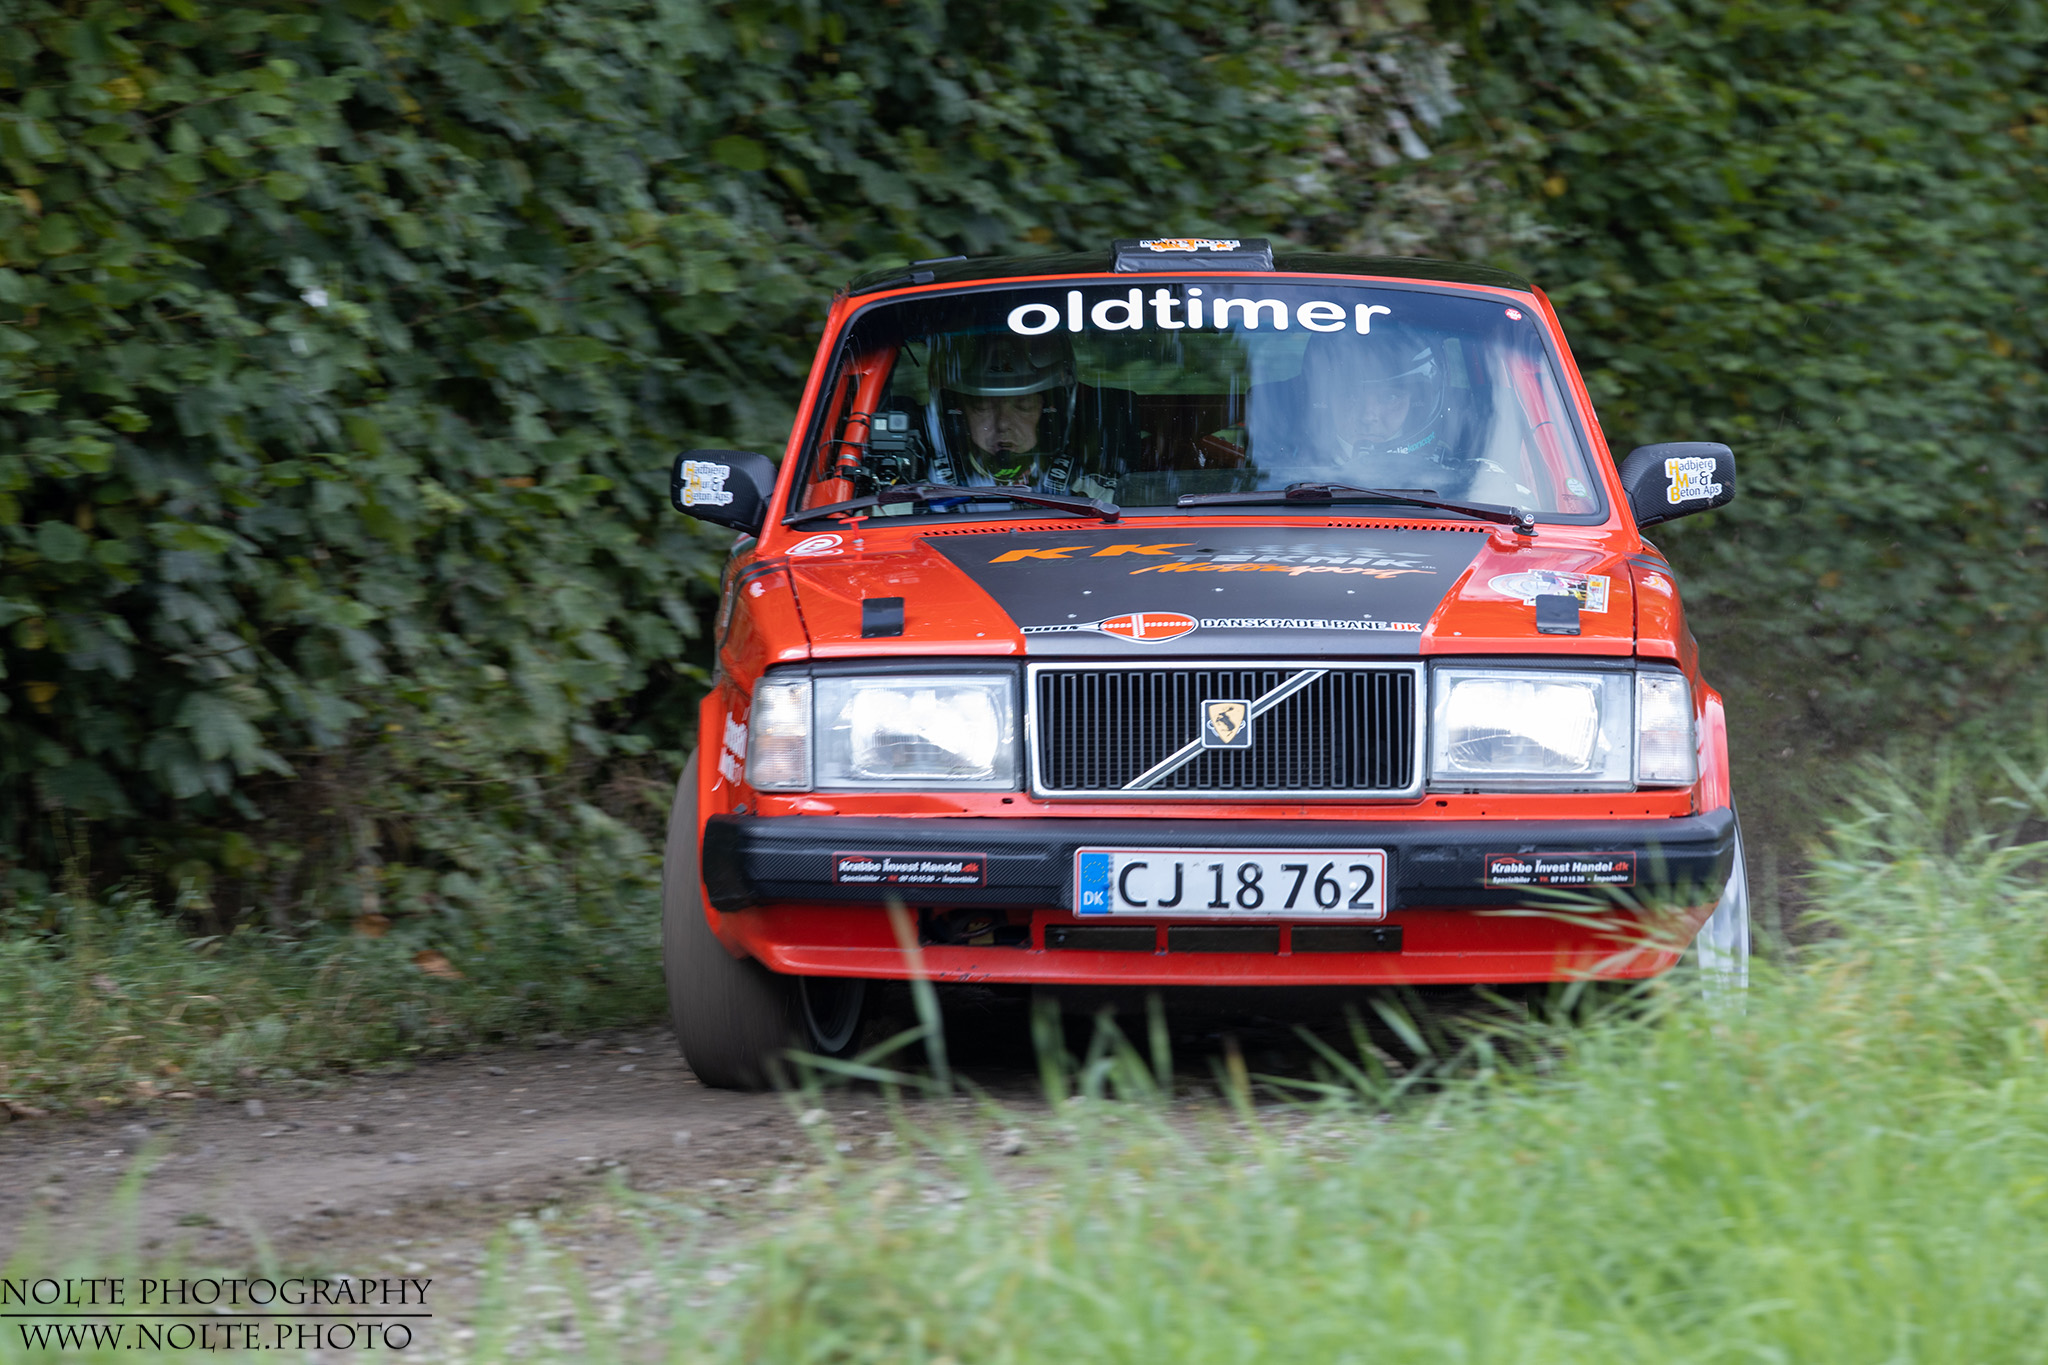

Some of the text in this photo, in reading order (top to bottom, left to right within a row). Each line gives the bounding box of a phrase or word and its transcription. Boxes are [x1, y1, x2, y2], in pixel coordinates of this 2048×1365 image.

[1007, 288, 1391, 335] oldtimer
[1668, 459, 1714, 475] Hadbjerg
[1676, 471, 1709, 488] Mur &
[1671, 485, 1720, 501] Beton Aps
[1171, 554, 1424, 568] TEKNIK
[1130, 562, 1437, 579] Motorsport
[1200, 618, 1422, 632] DANSKPADELBANE.DK
[1491, 859, 1629, 874] Krabbe Invest Handel.dk
[1118, 861, 1375, 910] CJ 18 762
[1083, 890, 1105, 906] DK
